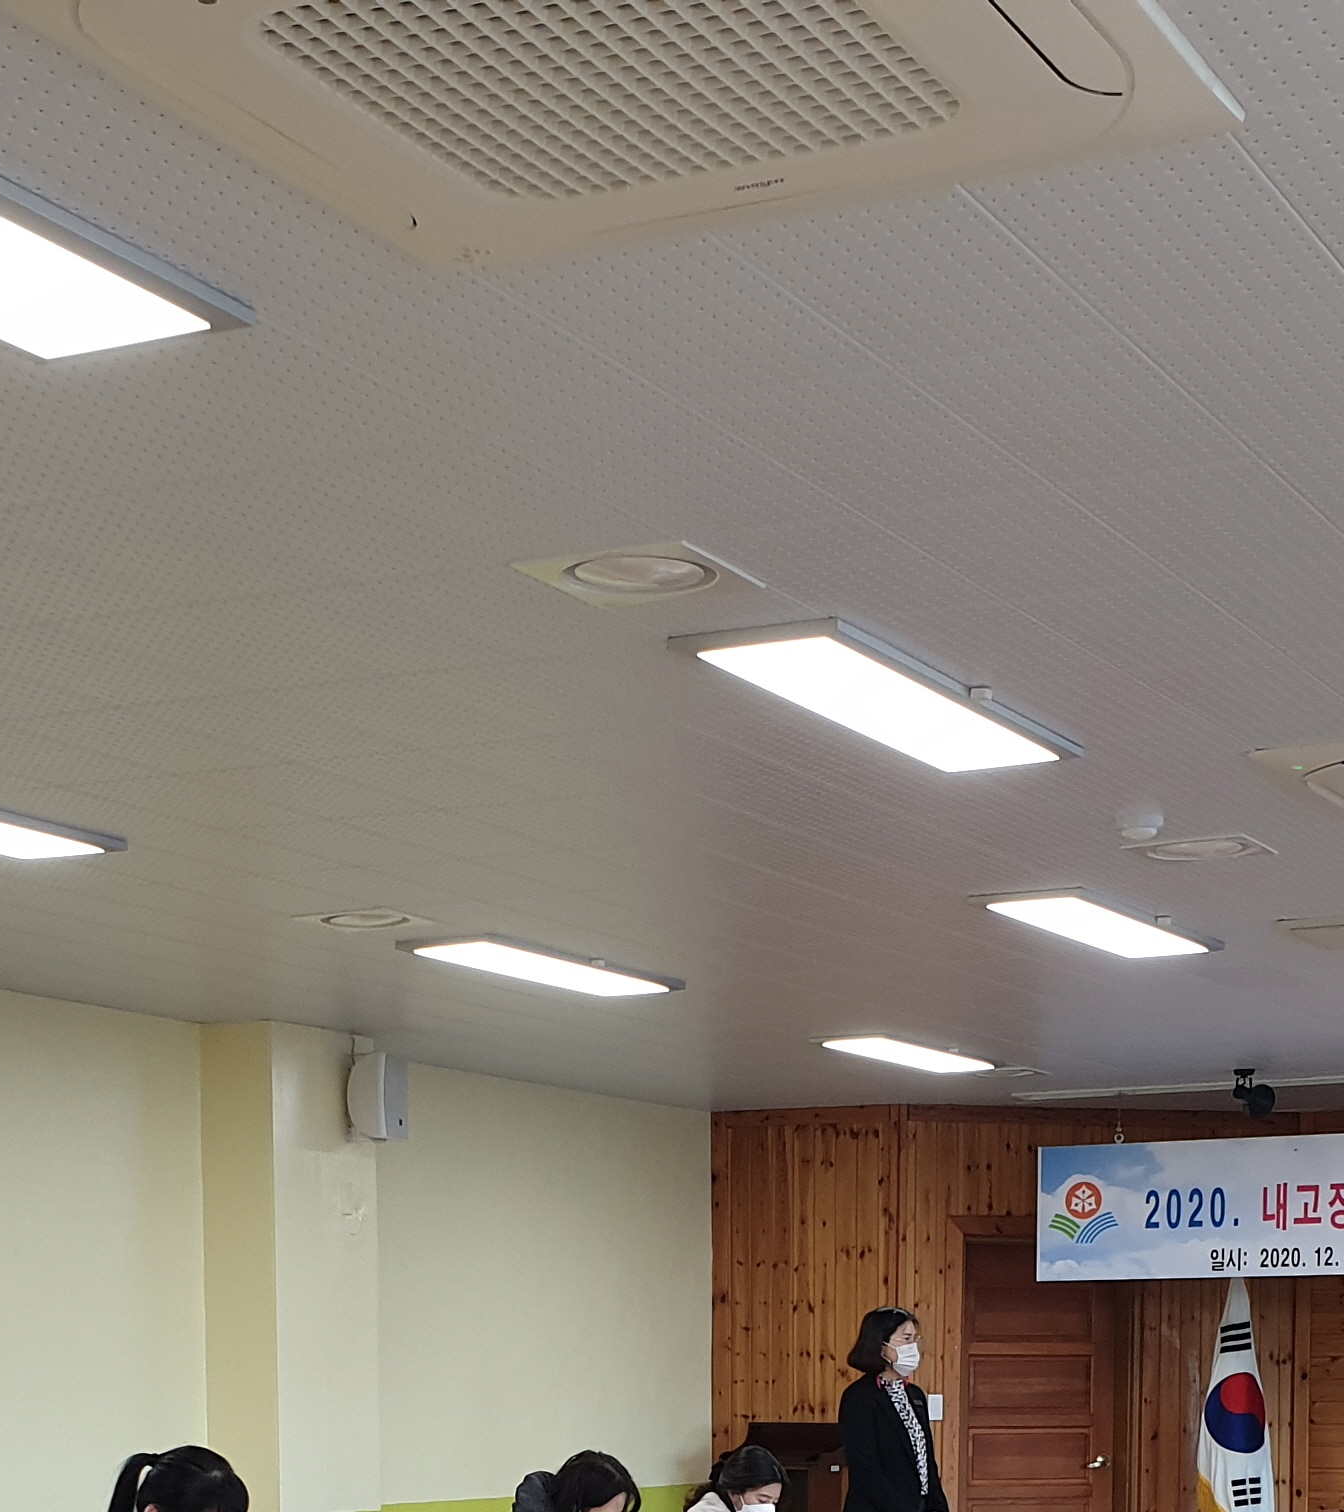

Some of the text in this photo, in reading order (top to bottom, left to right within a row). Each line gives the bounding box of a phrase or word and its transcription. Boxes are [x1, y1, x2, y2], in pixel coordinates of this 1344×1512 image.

[1144, 1186, 1240, 1230] 2020.
[1209, 1246, 1248, 1272] 일시:
[1259, 1247, 1306, 1269] 2020.
[1314, 1245, 1341, 1268] 12.
